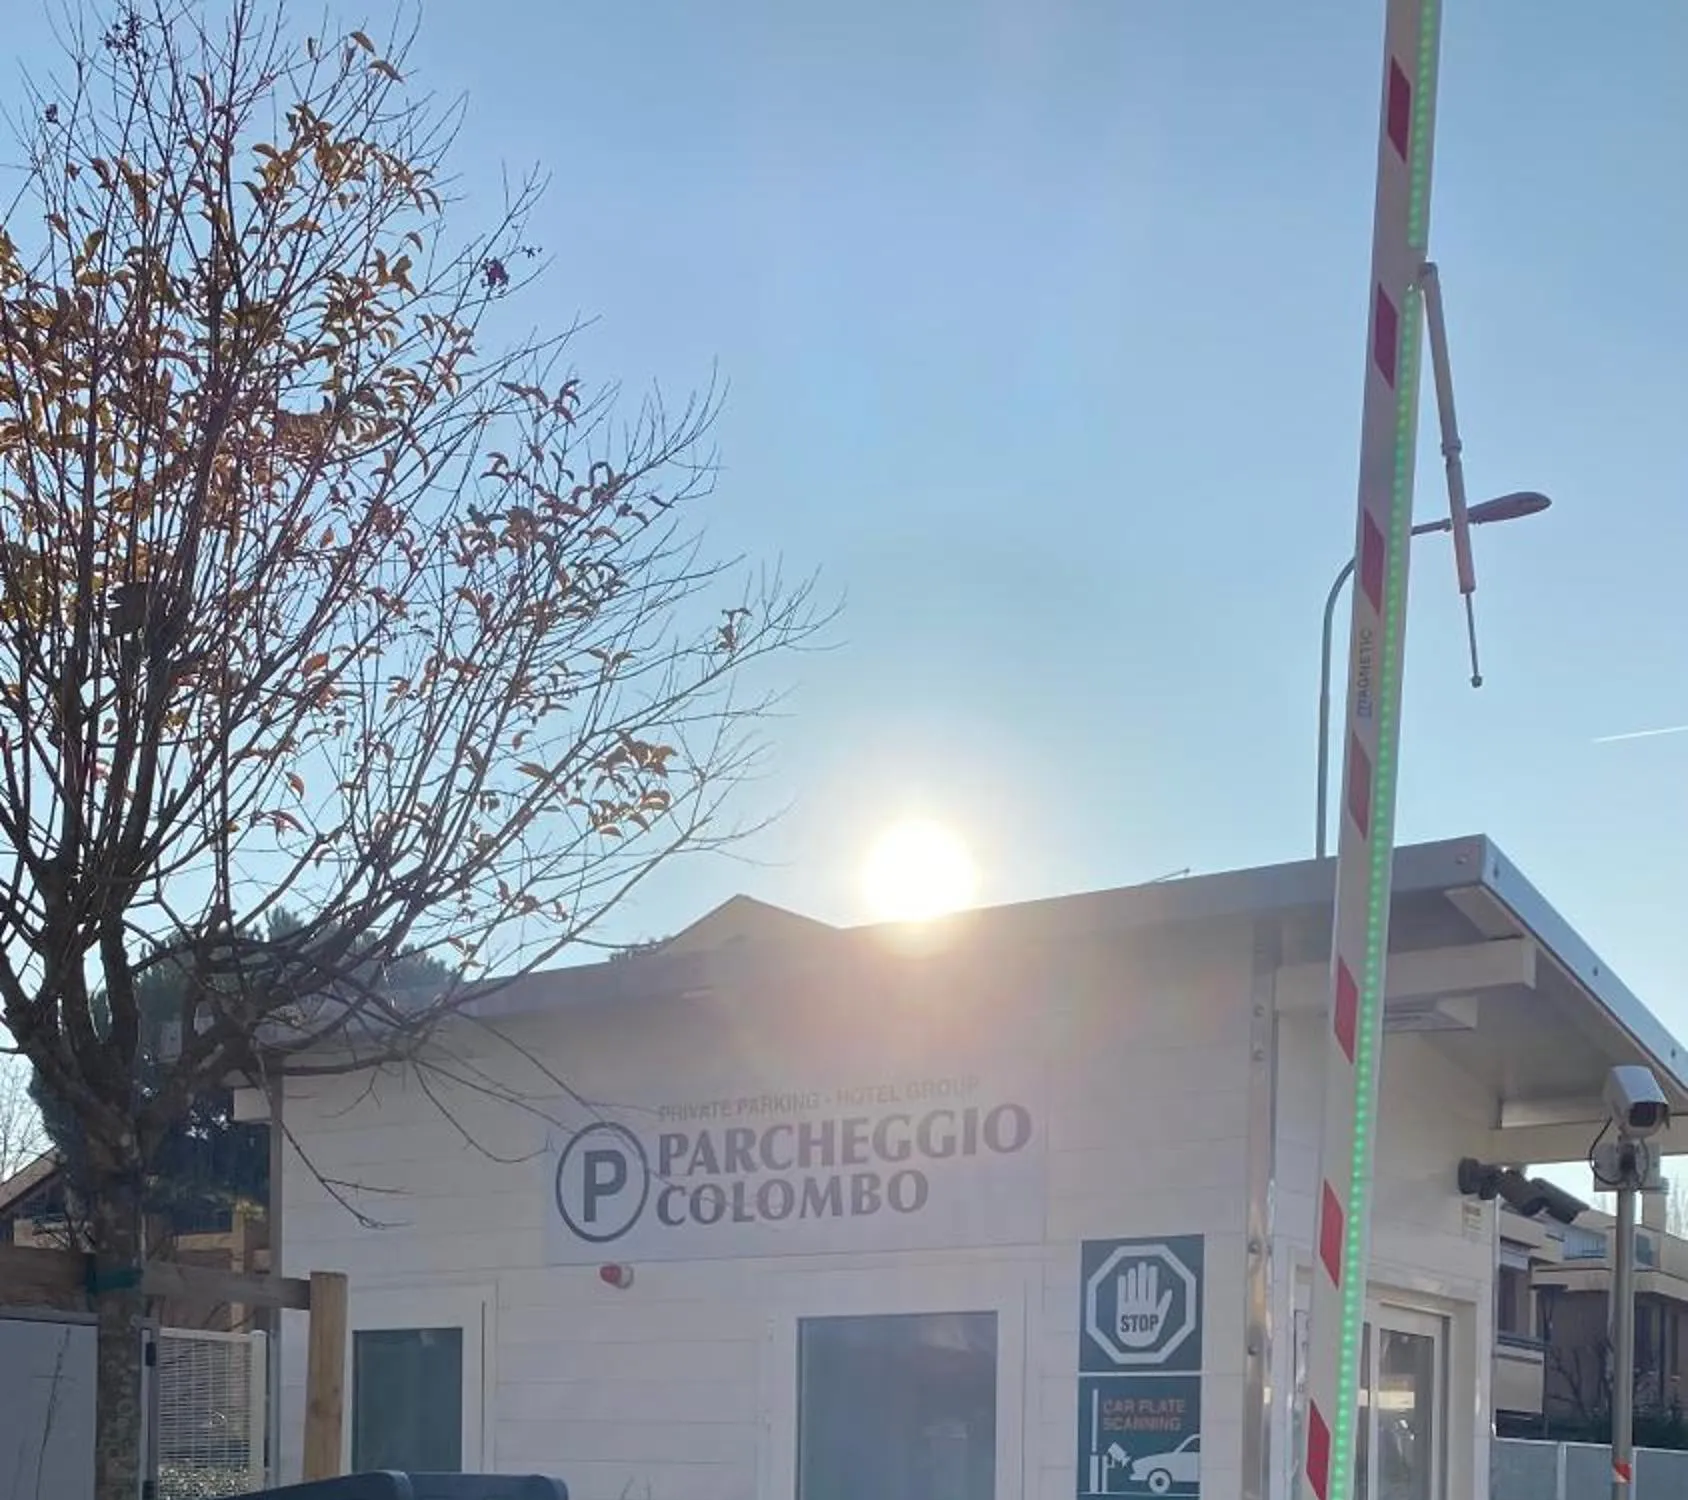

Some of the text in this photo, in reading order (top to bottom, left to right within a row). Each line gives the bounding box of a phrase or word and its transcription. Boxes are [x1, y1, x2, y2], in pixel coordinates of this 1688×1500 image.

[657, 1076, 980, 1122] PRIVATE PARKING HOTEL GROUP
[658, 1103, 1032, 1178] PARCHEGGIO
[583, 1149, 627, 1223] P
[656, 1169, 929, 1227] COLOMBO
[1120, 1314, 1159, 1334] STOP
[1103, 1398, 1187, 1414] CAR PLATE
[1103, 1417, 1182, 1432] SCANNING
